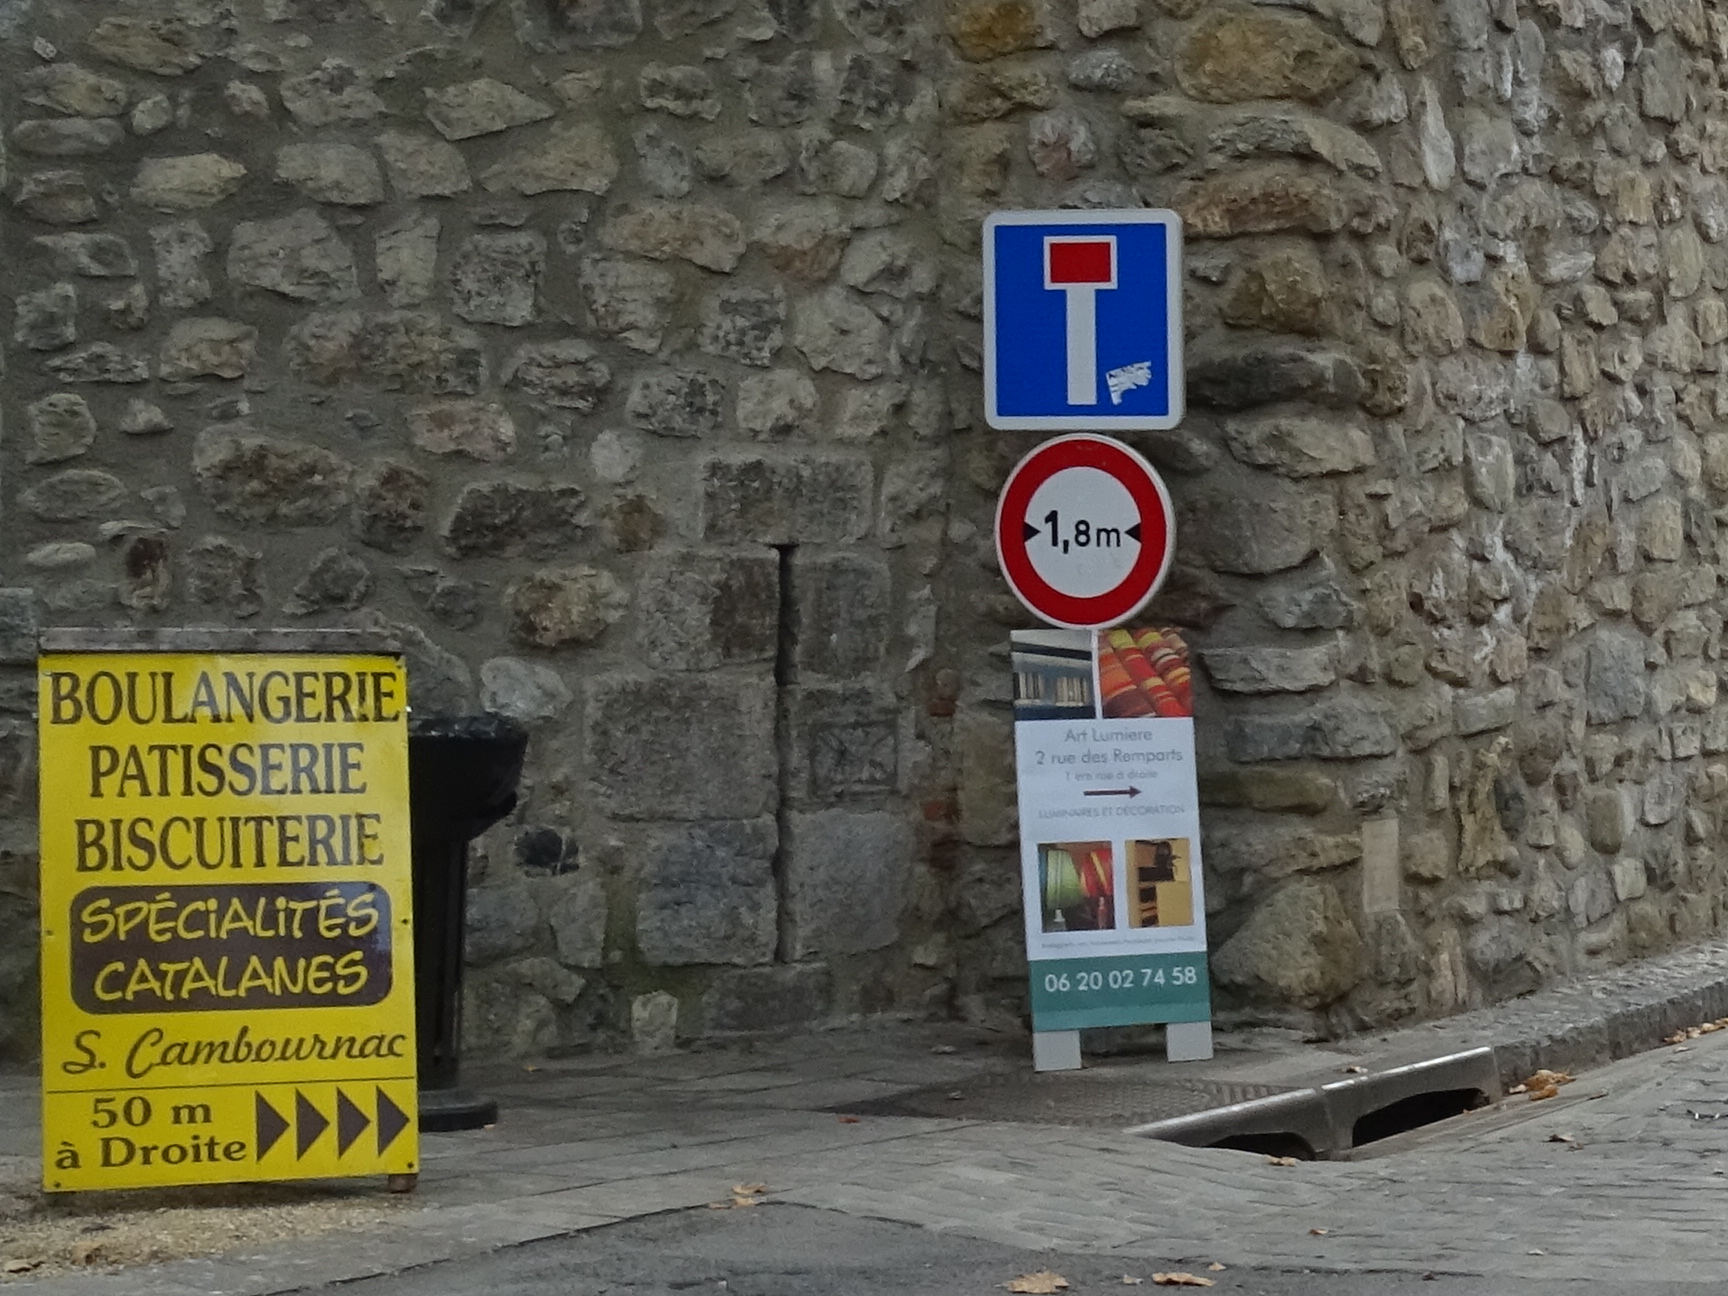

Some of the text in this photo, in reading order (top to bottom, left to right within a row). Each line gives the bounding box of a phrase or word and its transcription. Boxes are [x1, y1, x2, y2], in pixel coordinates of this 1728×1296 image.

[50, 670, 401, 725] BOULANGERIE
[1035, 748, 1184, 766] 2 rue des Remparts
[1064, 728, 1088, 744] Art
[89, 742, 367, 798] PATISSERIE
[76, 812, 385, 872] BISCUITERIE
[93, 950, 370, 1001] CATALANES
[1044, 965, 1198, 992] 06 20 02 74 58
[62, 1025, 407, 1079] S. Cambournac
[91, 1096, 213, 1129] 50 m
[55, 1135, 247, 1170] à Droite
